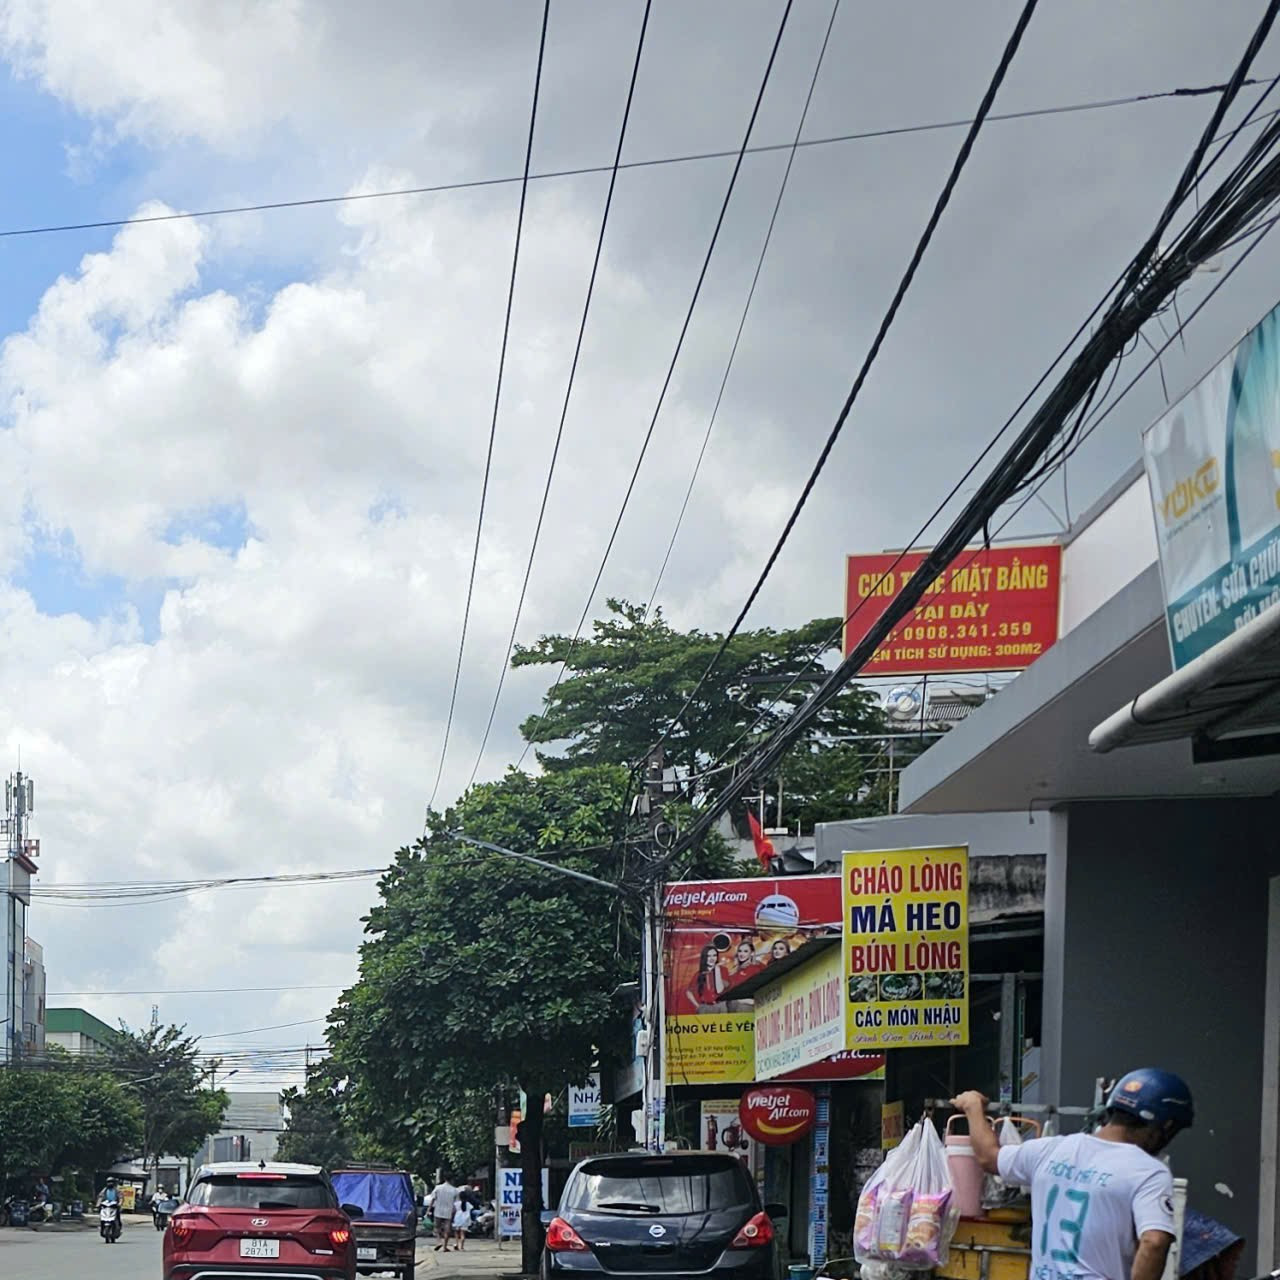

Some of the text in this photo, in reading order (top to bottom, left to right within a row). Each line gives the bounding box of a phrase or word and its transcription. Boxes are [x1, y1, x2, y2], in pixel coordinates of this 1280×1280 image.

[858, 573, 895, 597] CHO
[951, 563, 992, 598] MẶT
[914, 602, 990, 622] TẠI ĐÂY
[904, 622, 1032, 641] 0908.341.359
[894, 646, 924, 660] TÍCH
[995, 643, 1042, 657] 300M2
[850, 856, 962, 895] CHÁO LÒNG
[851, 898, 961, 934] MÁ HEO
[851, 935, 961, 973] BÚN LÒNG
[855, 1003, 961, 1028] CÁC MÓN NHẬU
[747, 1094, 791, 1110] Vietjet
[768, 1108, 810, 1120] Air.com
[1041, 1183, 1090, 1263] 13
